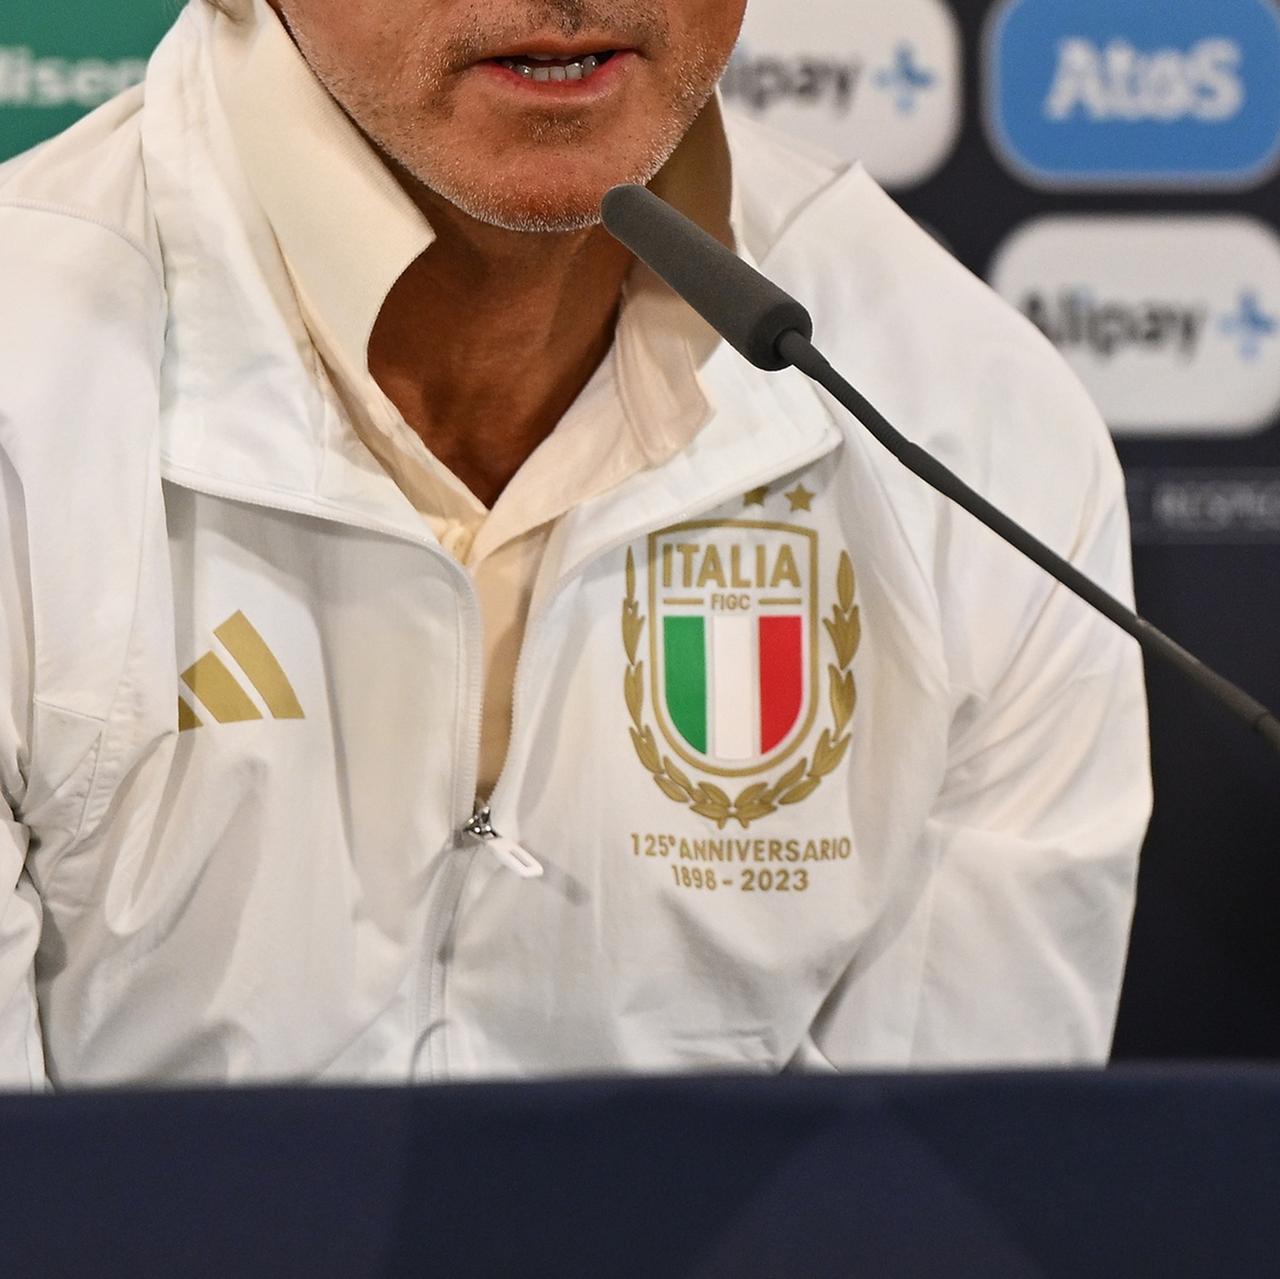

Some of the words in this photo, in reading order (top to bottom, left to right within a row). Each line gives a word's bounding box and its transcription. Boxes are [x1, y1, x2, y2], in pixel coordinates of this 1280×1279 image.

[662, 543, 801, 588] ITALIA
[710, 593, 751, 611] FIGC
[671, 864, 717, 891] 1898
[741, 868, 809, 892] 2023
